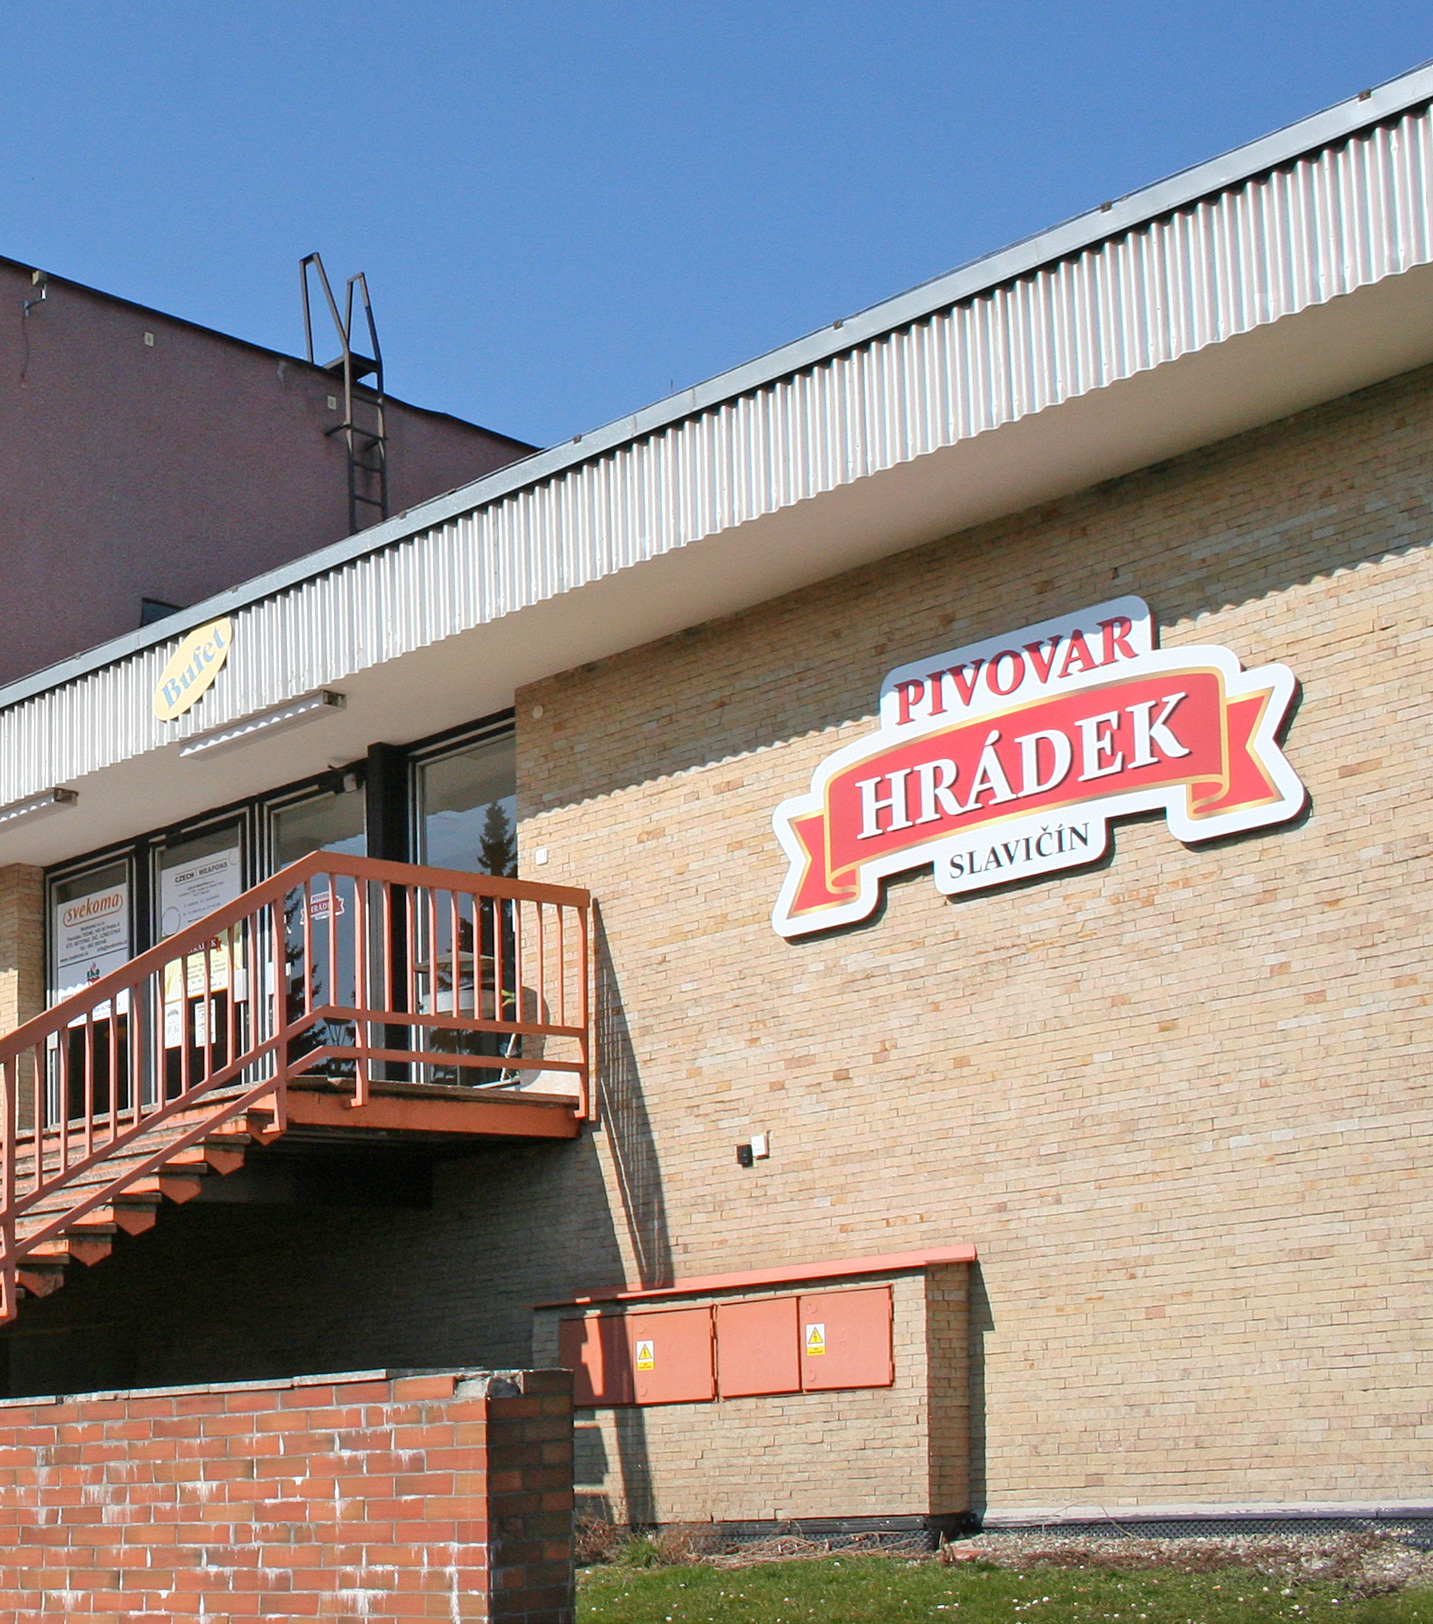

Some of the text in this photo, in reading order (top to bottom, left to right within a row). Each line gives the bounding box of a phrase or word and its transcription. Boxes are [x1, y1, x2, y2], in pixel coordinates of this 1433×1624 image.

[161, 627, 225, 708] Bufet
[893, 615, 1139, 725] PIVOVAR
[855, 691, 1190, 840] HRÁDEK
[175, 862, 228, 883] CZECH WEAPONS
[948, 821, 1091, 880] SLAVIČÍN
[67, 893, 120, 922] svekoma
